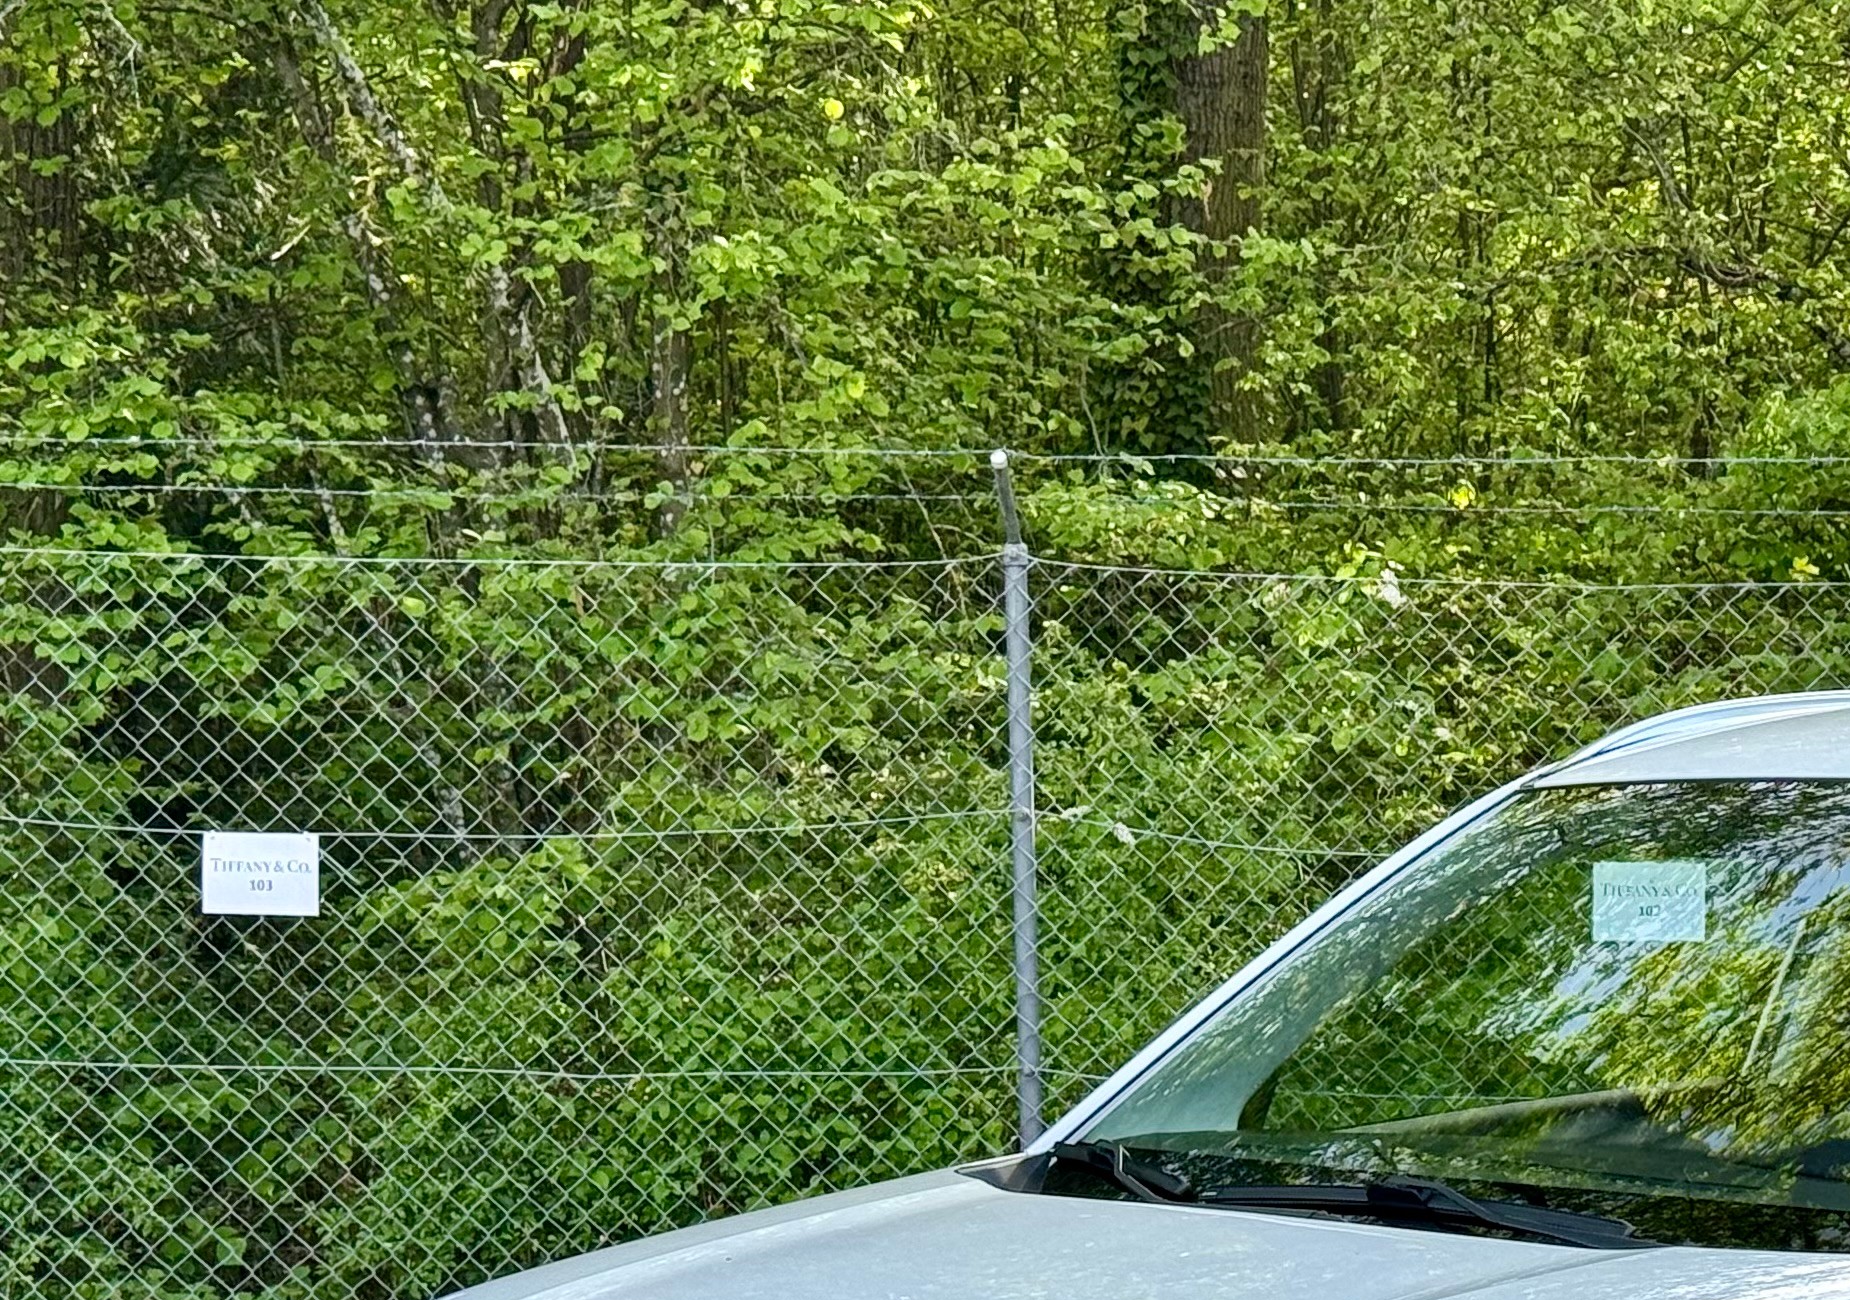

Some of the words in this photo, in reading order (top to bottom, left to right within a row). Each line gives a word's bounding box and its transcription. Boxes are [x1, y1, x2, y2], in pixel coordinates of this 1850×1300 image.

[209, 857, 272, 873] TIFFANY
[273, 860, 285, 873] &
[248, 879, 274, 892] 103
